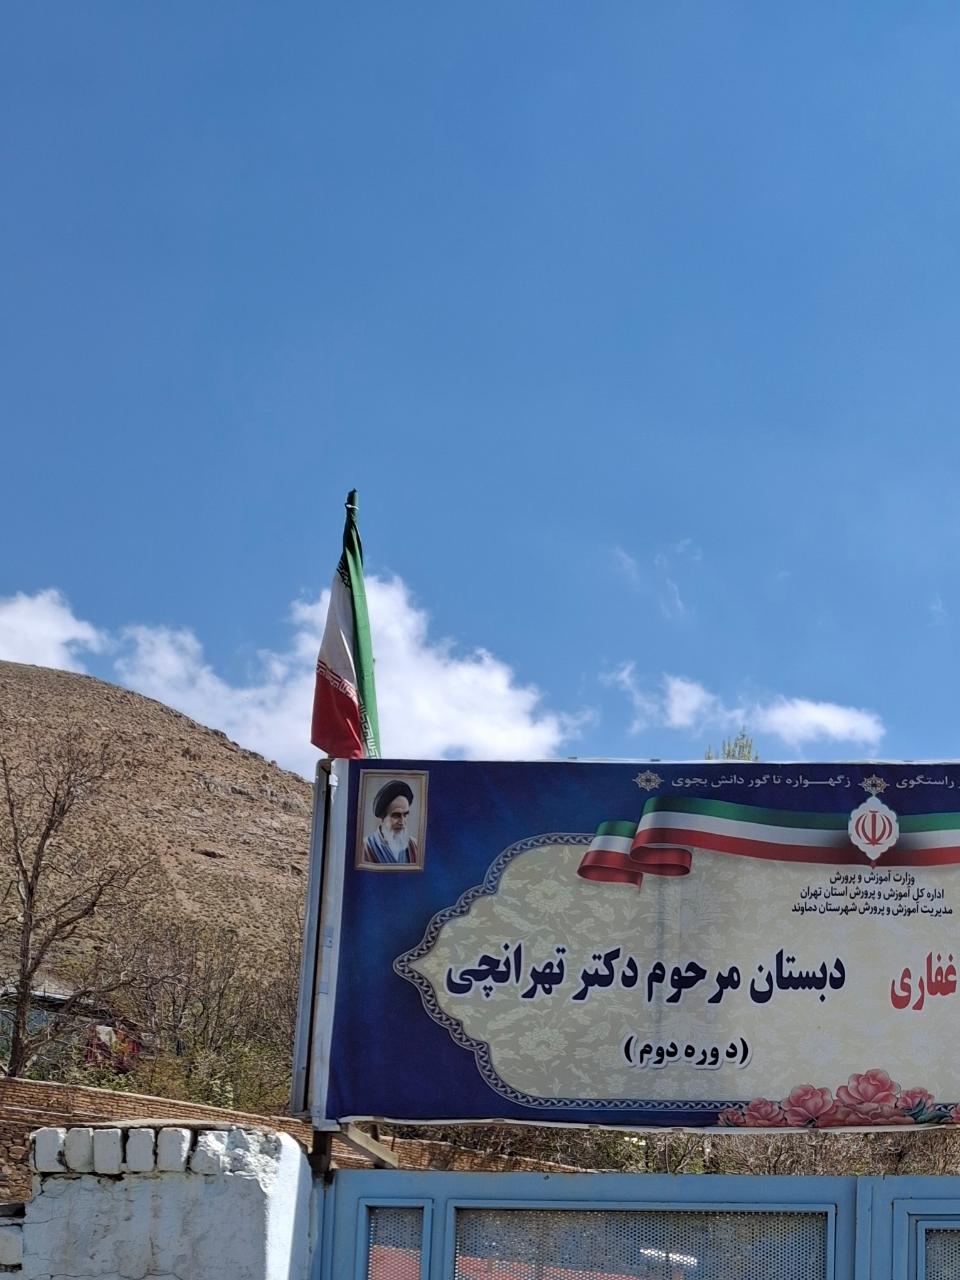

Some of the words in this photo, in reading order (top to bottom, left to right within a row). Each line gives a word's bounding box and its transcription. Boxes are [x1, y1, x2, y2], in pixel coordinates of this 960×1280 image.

[895, 775, 955, 789] راستگوی
[829, 871, 856, 884] پرورش
[863, 870, 892, 884] آموزش
[892, 872, 915, 885] وزارت
[800, 886, 822, 899] تهران
[823, 886, 848, 899] استان
[849, 887, 875, 900] پرورش
[883, 886, 911, 900] آموزش
[912, 887, 925, 901] کل
[926, 888, 945, 901] اداره
[791, 902, 817, 915] دماوند
[818, 902, 858, 915] شهرستان
[858, 903, 885, 916] پرورش
[891, 902, 920, 916] آموزش
[920, 904, 953, 917] مدیریت
[446, 942, 565, 999] تهرانچی
[571, 947, 639, 1001] دکتر
[749, 949, 846, 1003] دبستان
[646, 957, 741, 1003] مرحوم
[890, 951, 957, 1011] غفاری
